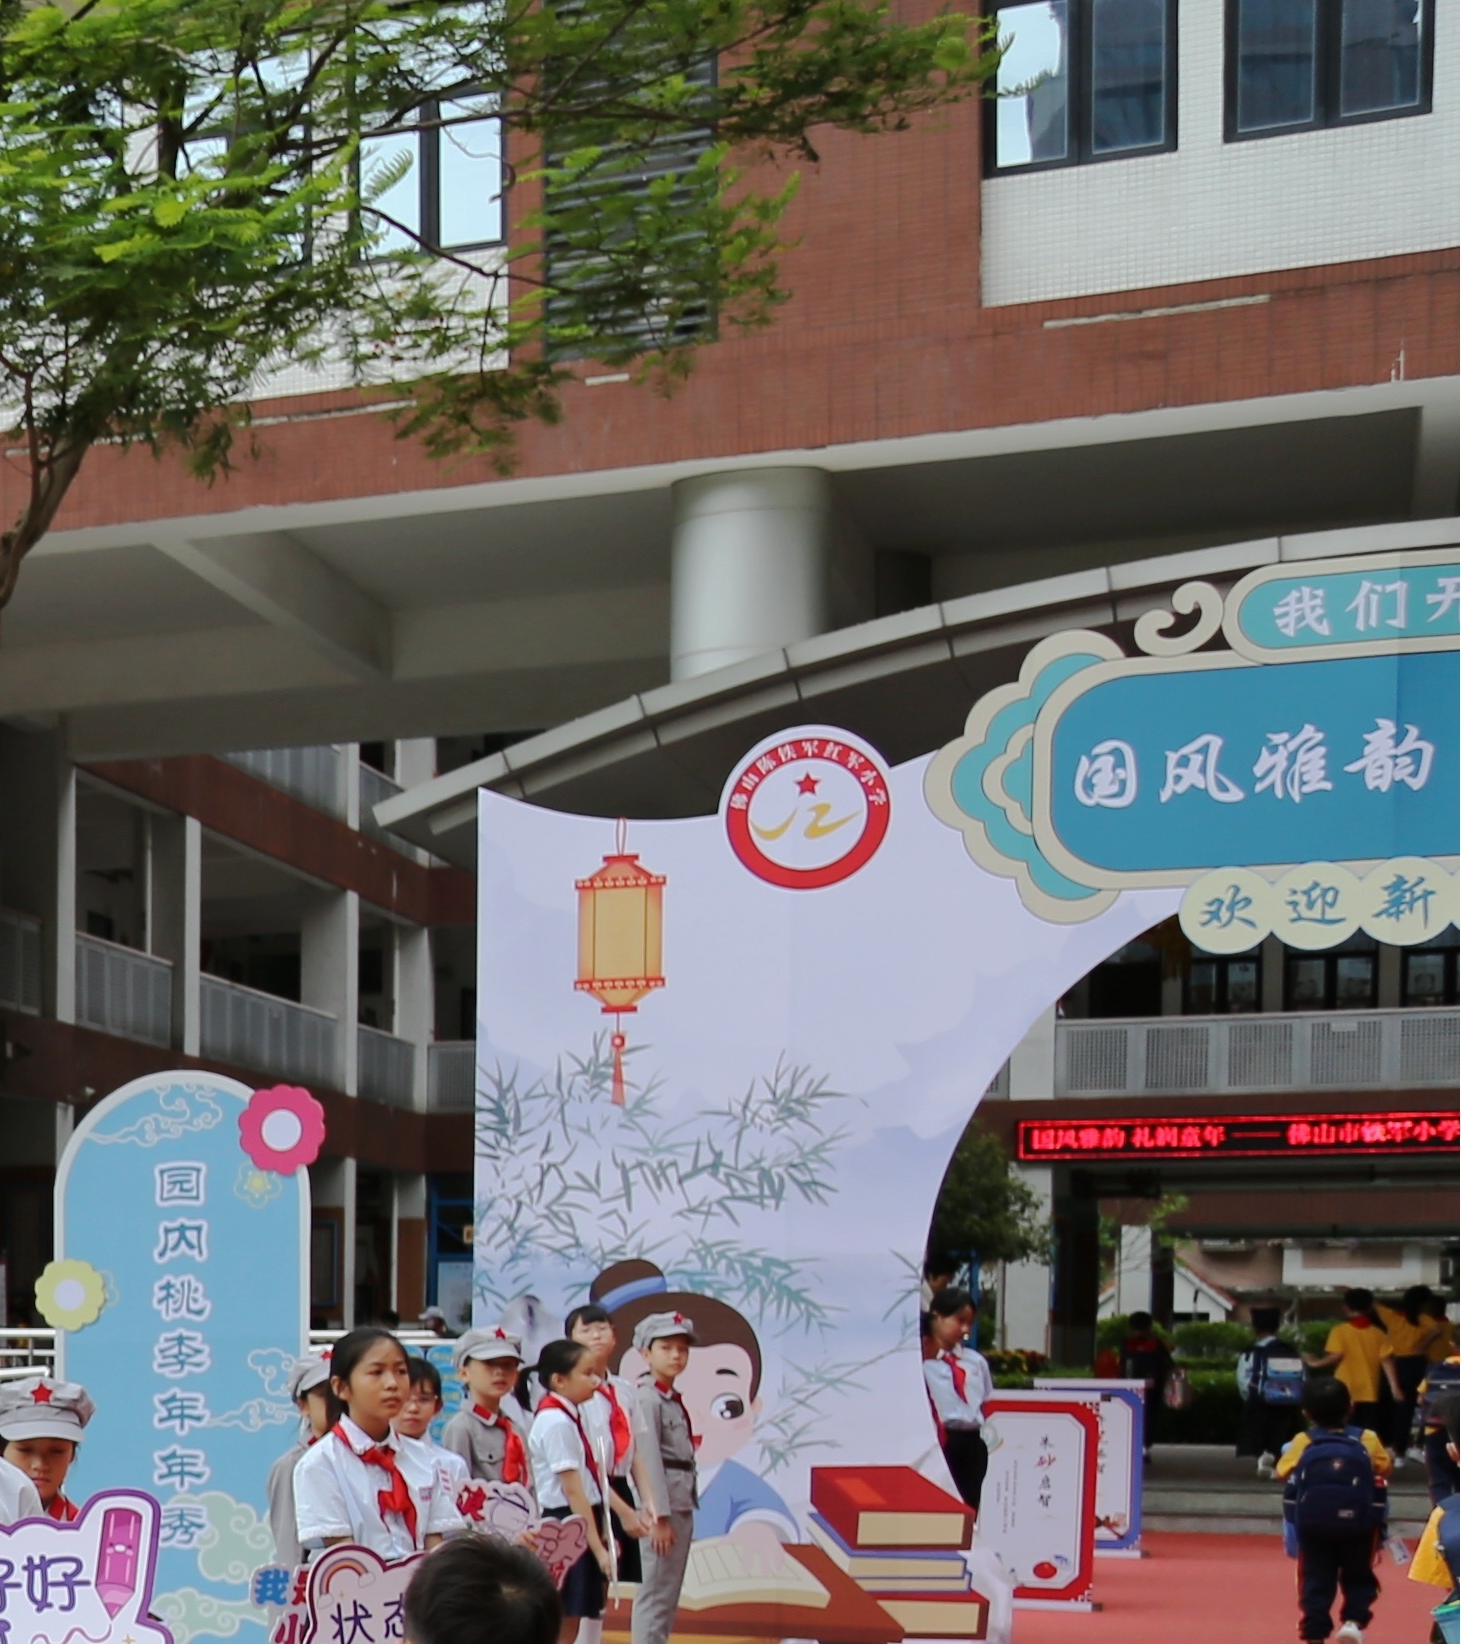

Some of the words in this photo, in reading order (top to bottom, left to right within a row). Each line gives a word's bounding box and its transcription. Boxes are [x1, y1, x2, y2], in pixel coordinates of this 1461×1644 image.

[1073, 718, 1436, 808] 国风雅韵
[1199, 873, 1438, 930] 欢迎新
[155, 1163, 209, 1547] 园内桃李年年秀
